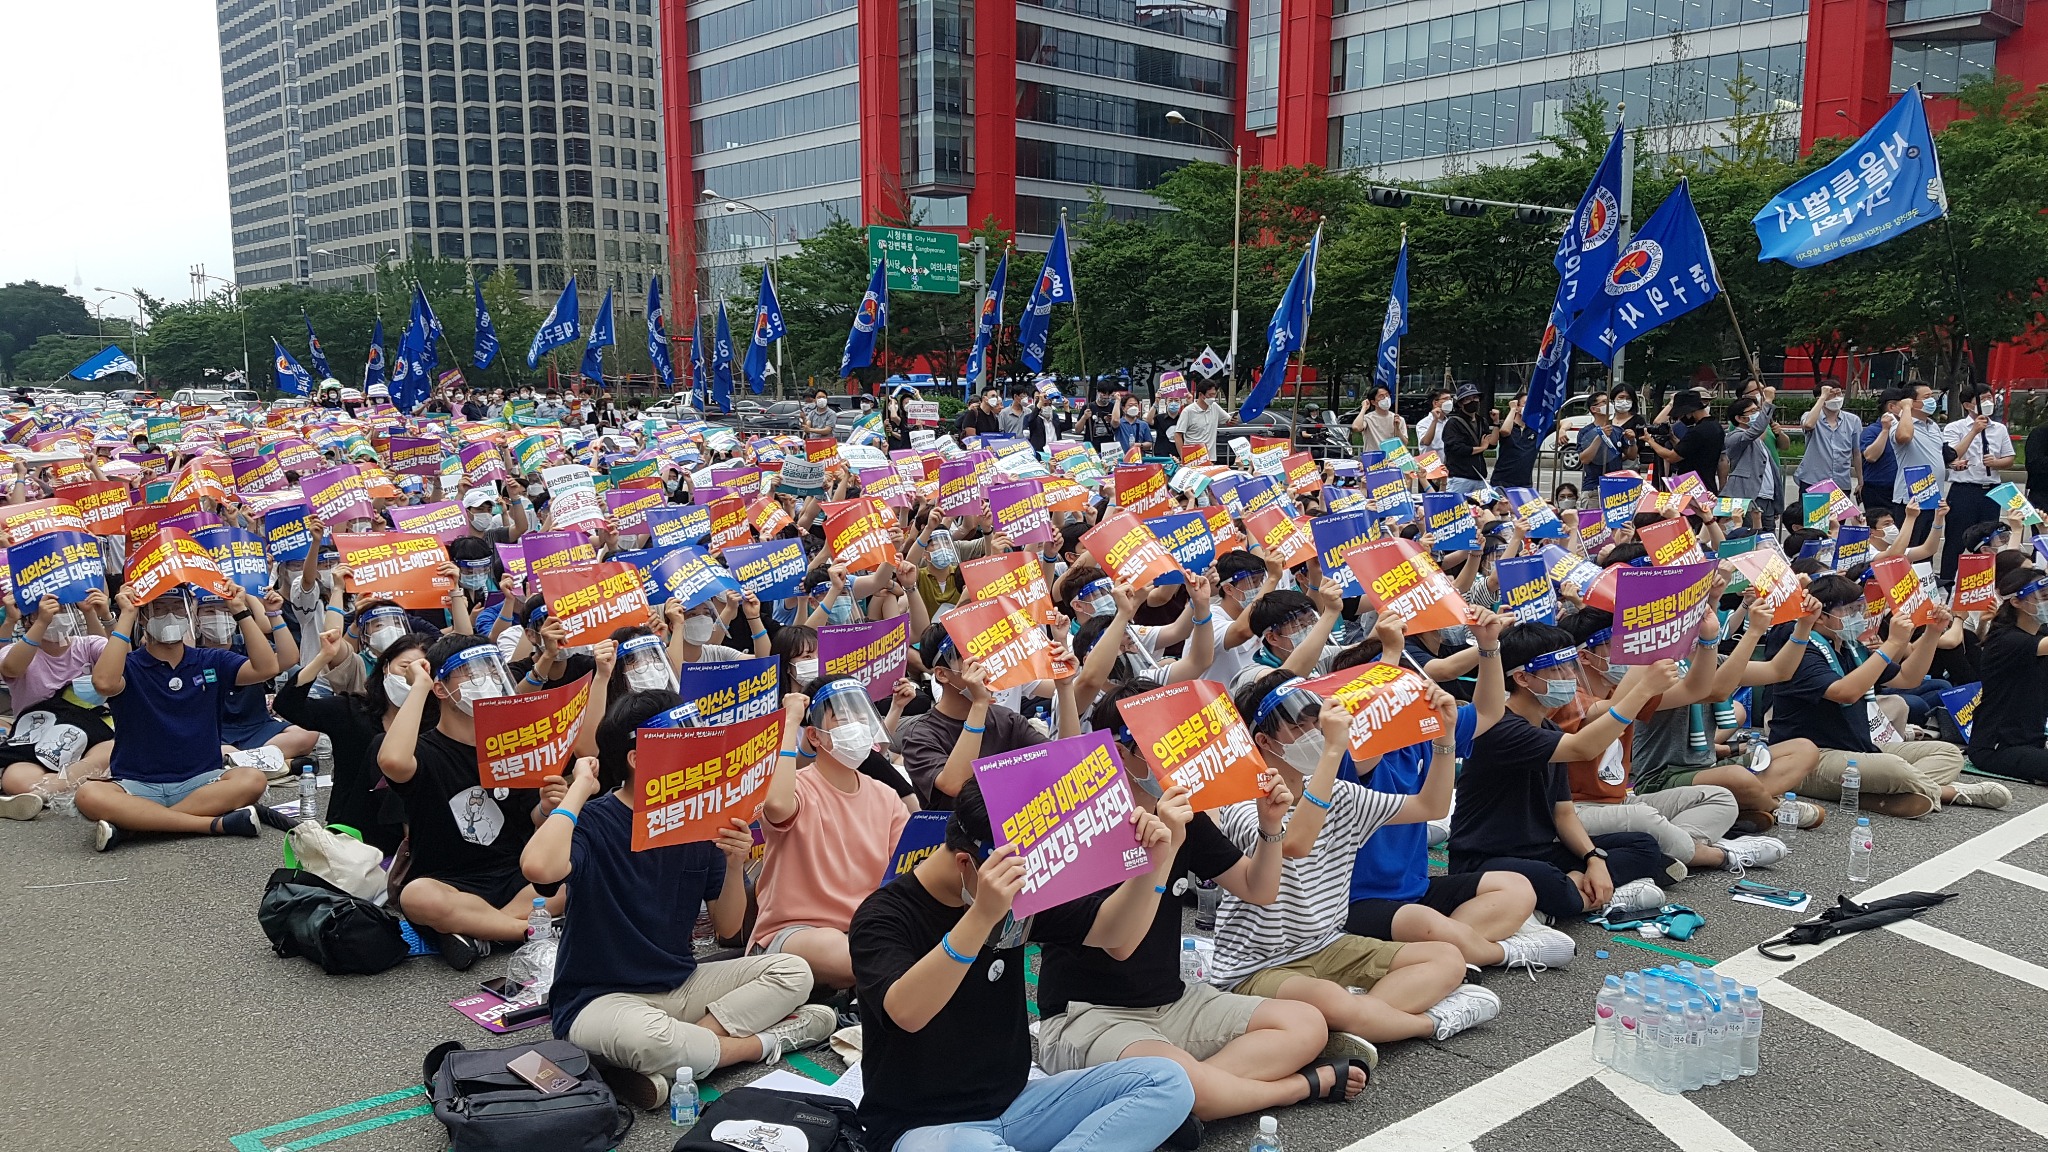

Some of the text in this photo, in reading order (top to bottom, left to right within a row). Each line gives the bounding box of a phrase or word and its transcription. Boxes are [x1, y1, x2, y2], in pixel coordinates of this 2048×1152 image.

[311, 485, 345, 508] 무분별한
[941, 478, 965, 497] 무분별한
[941, 491, 971, 511] 국민건강
[1121, 483, 1148, 506] 의무복무
[1604, 493, 1628, 509] 내외산소
[6, 507, 47, 527] 의무복무
[316, 492, 355, 520] 국민건강
[400, 506, 461, 530] 무분별한 비대면진료
[997, 498, 1032, 525] 무분별한
[1207, 509, 1231, 532] 강제전공
[1607, 506, 1629, 522] 의학근본
[269, 521, 302, 542] 내외산소
[653, 508, 709, 536] 내외산소 필수의료
[832, 515, 870, 554] 의무복무
[1001, 514, 1041, 540] 국민건강
[1173, 518, 1205, 547] 필수의료
[230, 540, 262, 558] 필수의료
[270, 531, 308, 556] 의학근본
[346, 537, 438, 567] 의무복무 강제전공
[658, 530, 686, 546] 의학근본
[1105, 526, 1146, 570] 의무복무
[1182, 534, 1212, 563] 대우하라
[1655, 534, 1688, 565] 의무복무
[16, 551, 61, 586] 내외산소
[129, 541, 173, 582] 의무복무
[134, 555, 182, 597] 전문가가
[232, 556, 266, 576] 대우하라
[353, 551, 446, 586] 전문가가 노예인가
[531, 554, 570, 577] 무분별한
[665, 558, 701, 591] 내외산소
[736, 545, 801, 581] 내외산소 필수의료
[773, 558, 805, 584] 대우하라
[1014, 559, 1042, 585] 강제전공
[21, 574, 70, 604] 의학근본
[553, 570, 640, 617] 의무복무 강제전공
[675, 572, 712, 604] 의학근본
[1371, 564, 1418, 601] 의무복무
[1507, 576, 1549, 606] 내외산소
[1514, 595, 1552, 627] 의학근본
[1622, 599, 1677, 631] 무분별한
[1678, 568, 1715, 613] 비대면진료
[561, 607, 608, 639] 전문가가
[967, 618, 1013, 657] 의무복무
[1622, 620, 1682, 655] 국민건강
[825, 622, 906, 676] 무분별한 비대면진료
[872, 642, 906, 680] 무너진다
[738, 663, 778, 697] 필수의료
[674, 709, 688, 717] Face
[1419, 716, 1438, 728] KMA
[486, 717, 552, 757] 의무복무
[1152, 721, 1210, 770] 의무복무
[490, 748, 557, 781] 전문가가
[646, 721, 779, 805] 의무복무 강제전공
[647, 750, 777, 838] 전문가가 노예인가
[1002, 743, 1119, 855] 무분별한 비대면진료
[1077, 778, 1134, 852] 무너진다
[1122, 846, 1147, 861] KMA
[1674, 1035, 1684, 1043] 석수
[1707, 1027, 1719, 1035] 석수
[1729, 1024, 1740, 1032] 석수
